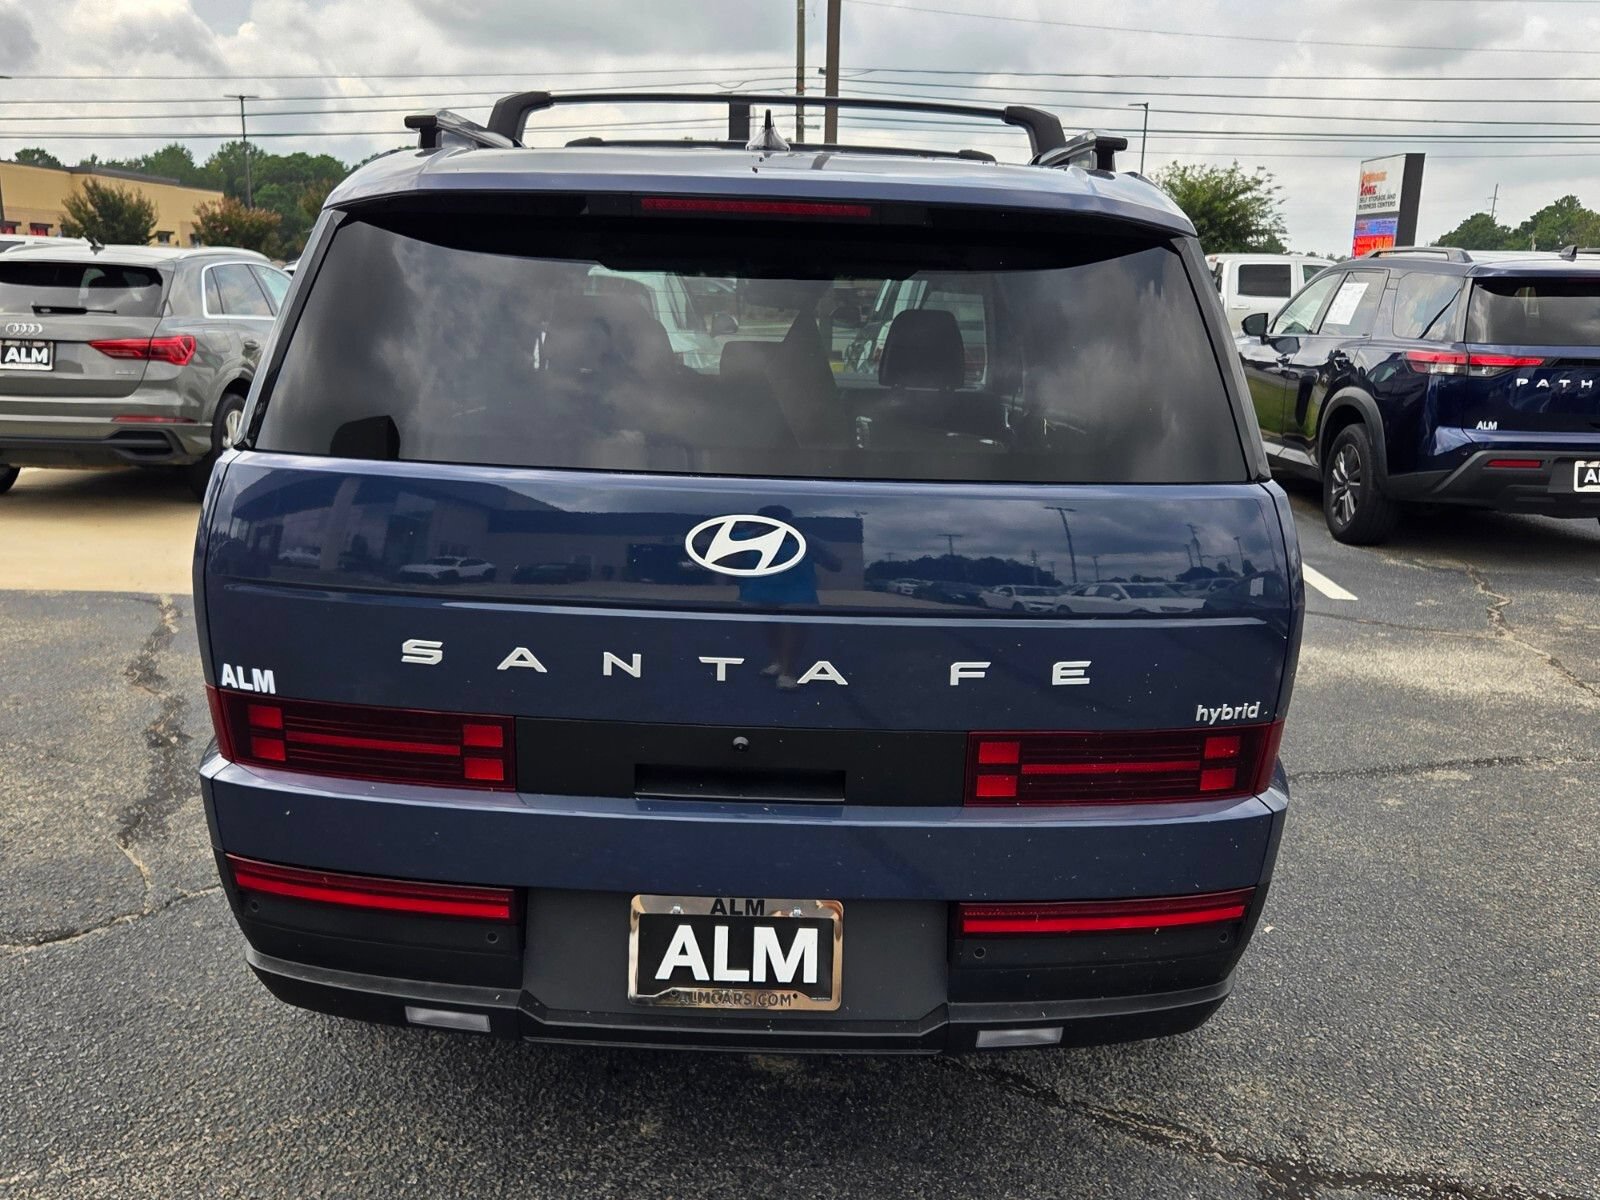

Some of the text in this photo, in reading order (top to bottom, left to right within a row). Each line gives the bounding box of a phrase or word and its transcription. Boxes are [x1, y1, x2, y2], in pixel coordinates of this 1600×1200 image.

[4, 347, 49, 364] ALM
[1476, 421, 1498, 431] ALM
[401, 638, 1092, 686] SANTA FE
[221, 663, 276, 695] ALM
[1195, 701, 1261, 726] hybrid
[710, 898, 765, 916] ALM
[654, 924, 818, 984] ALM
[678, 991, 792, 1008] ALMCARS.COM
